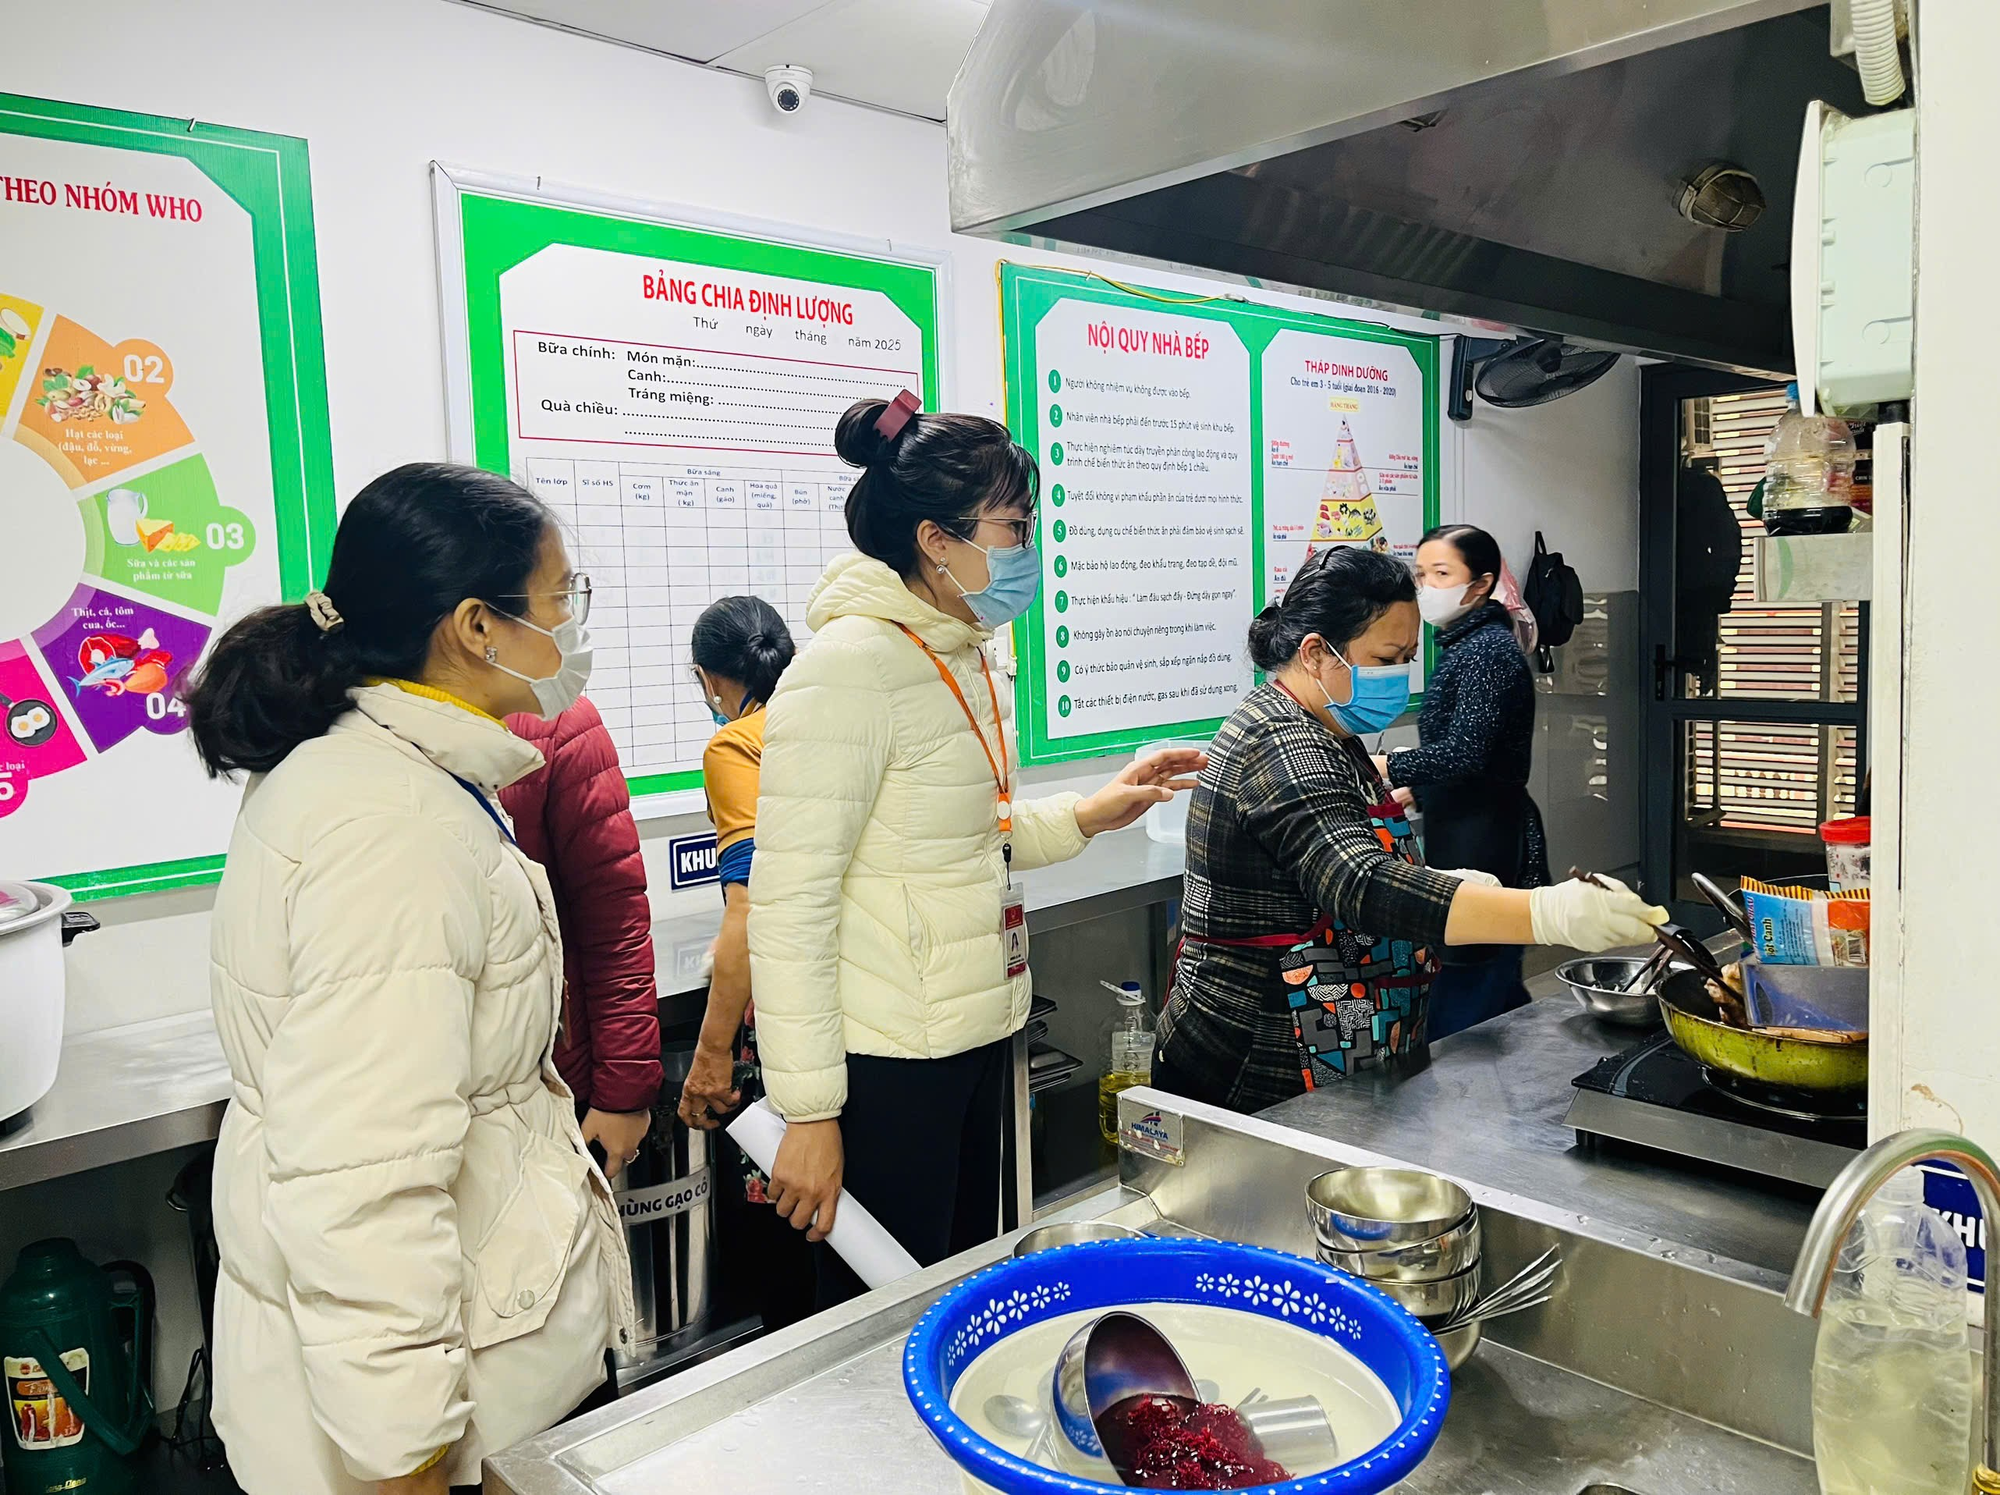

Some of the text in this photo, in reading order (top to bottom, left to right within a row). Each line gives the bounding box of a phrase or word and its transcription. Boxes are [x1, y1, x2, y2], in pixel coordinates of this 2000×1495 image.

[0, 176, 202, 223] HEO NHÓM WHO
[643, 270, 852, 328] BẢNG CHIA ĐỊNH LƯỢNG
[693, 316, 718, 330] Thứ
[745, 321, 772, 338] ngày
[795, 327, 827, 345] tháng
[848, 336, 871, 348] năm
[1088, 320, 1209, 359] NỘI QUY NHÀ BẾP
[538, 341, 615, 359] Bữa chính:
[627, 350, 657, 365] Món
[123, 354, 164, 383] 02
[627, 368, 667, 383] Canh:
[1305, 360, 1388, 381] THÁP DINH DƯỠNG
[1053, 376, 1057, 386] 1
[1086, 379, 1104, 392] không
[1320, 379, 1323, 388] 3
[1328, 380, 1331, 389] 5
[1367, 385, 1379, 394] 2016
[628, 387, 715, 406] Tráng miệng:
[541, 399, 618, 415] Quà chiều:
[1054, 410, 1058, 420] 2
[1170, 419, 1177, 428] 15
[65, 428, 124, 441] Hạt các loại
[83, 455, 98, 466] lạc
[635, 493, 650, 501] (kg)
[206, 523, 244, 550] 03
[127, 558, 146, 568] Sữa
[149, 559, 160, 568] và
[162, 559, 178, 567] các
[71, 606, 134, 618] Thịt, cá, tôm
[82, 622, 104, 630] cua,
[1061, 666, 1066, 675] 9
[1074, 665, 1083, 674] Có
[146, 692, 186, 720] 04
[1061, 701, 1070, 710] 10
[1157, 692, 1167, 702] gas
[1168, 690, 1179, 698] sau
[6, 760, 26, 772] loại
[680, 847, 717, 874] KHU
[1762, 917, 1773, 942] Canh
[1131, 1122, 1168, 1140] HIMALAYA
[665, 1189, 693, 1210] GẠO
